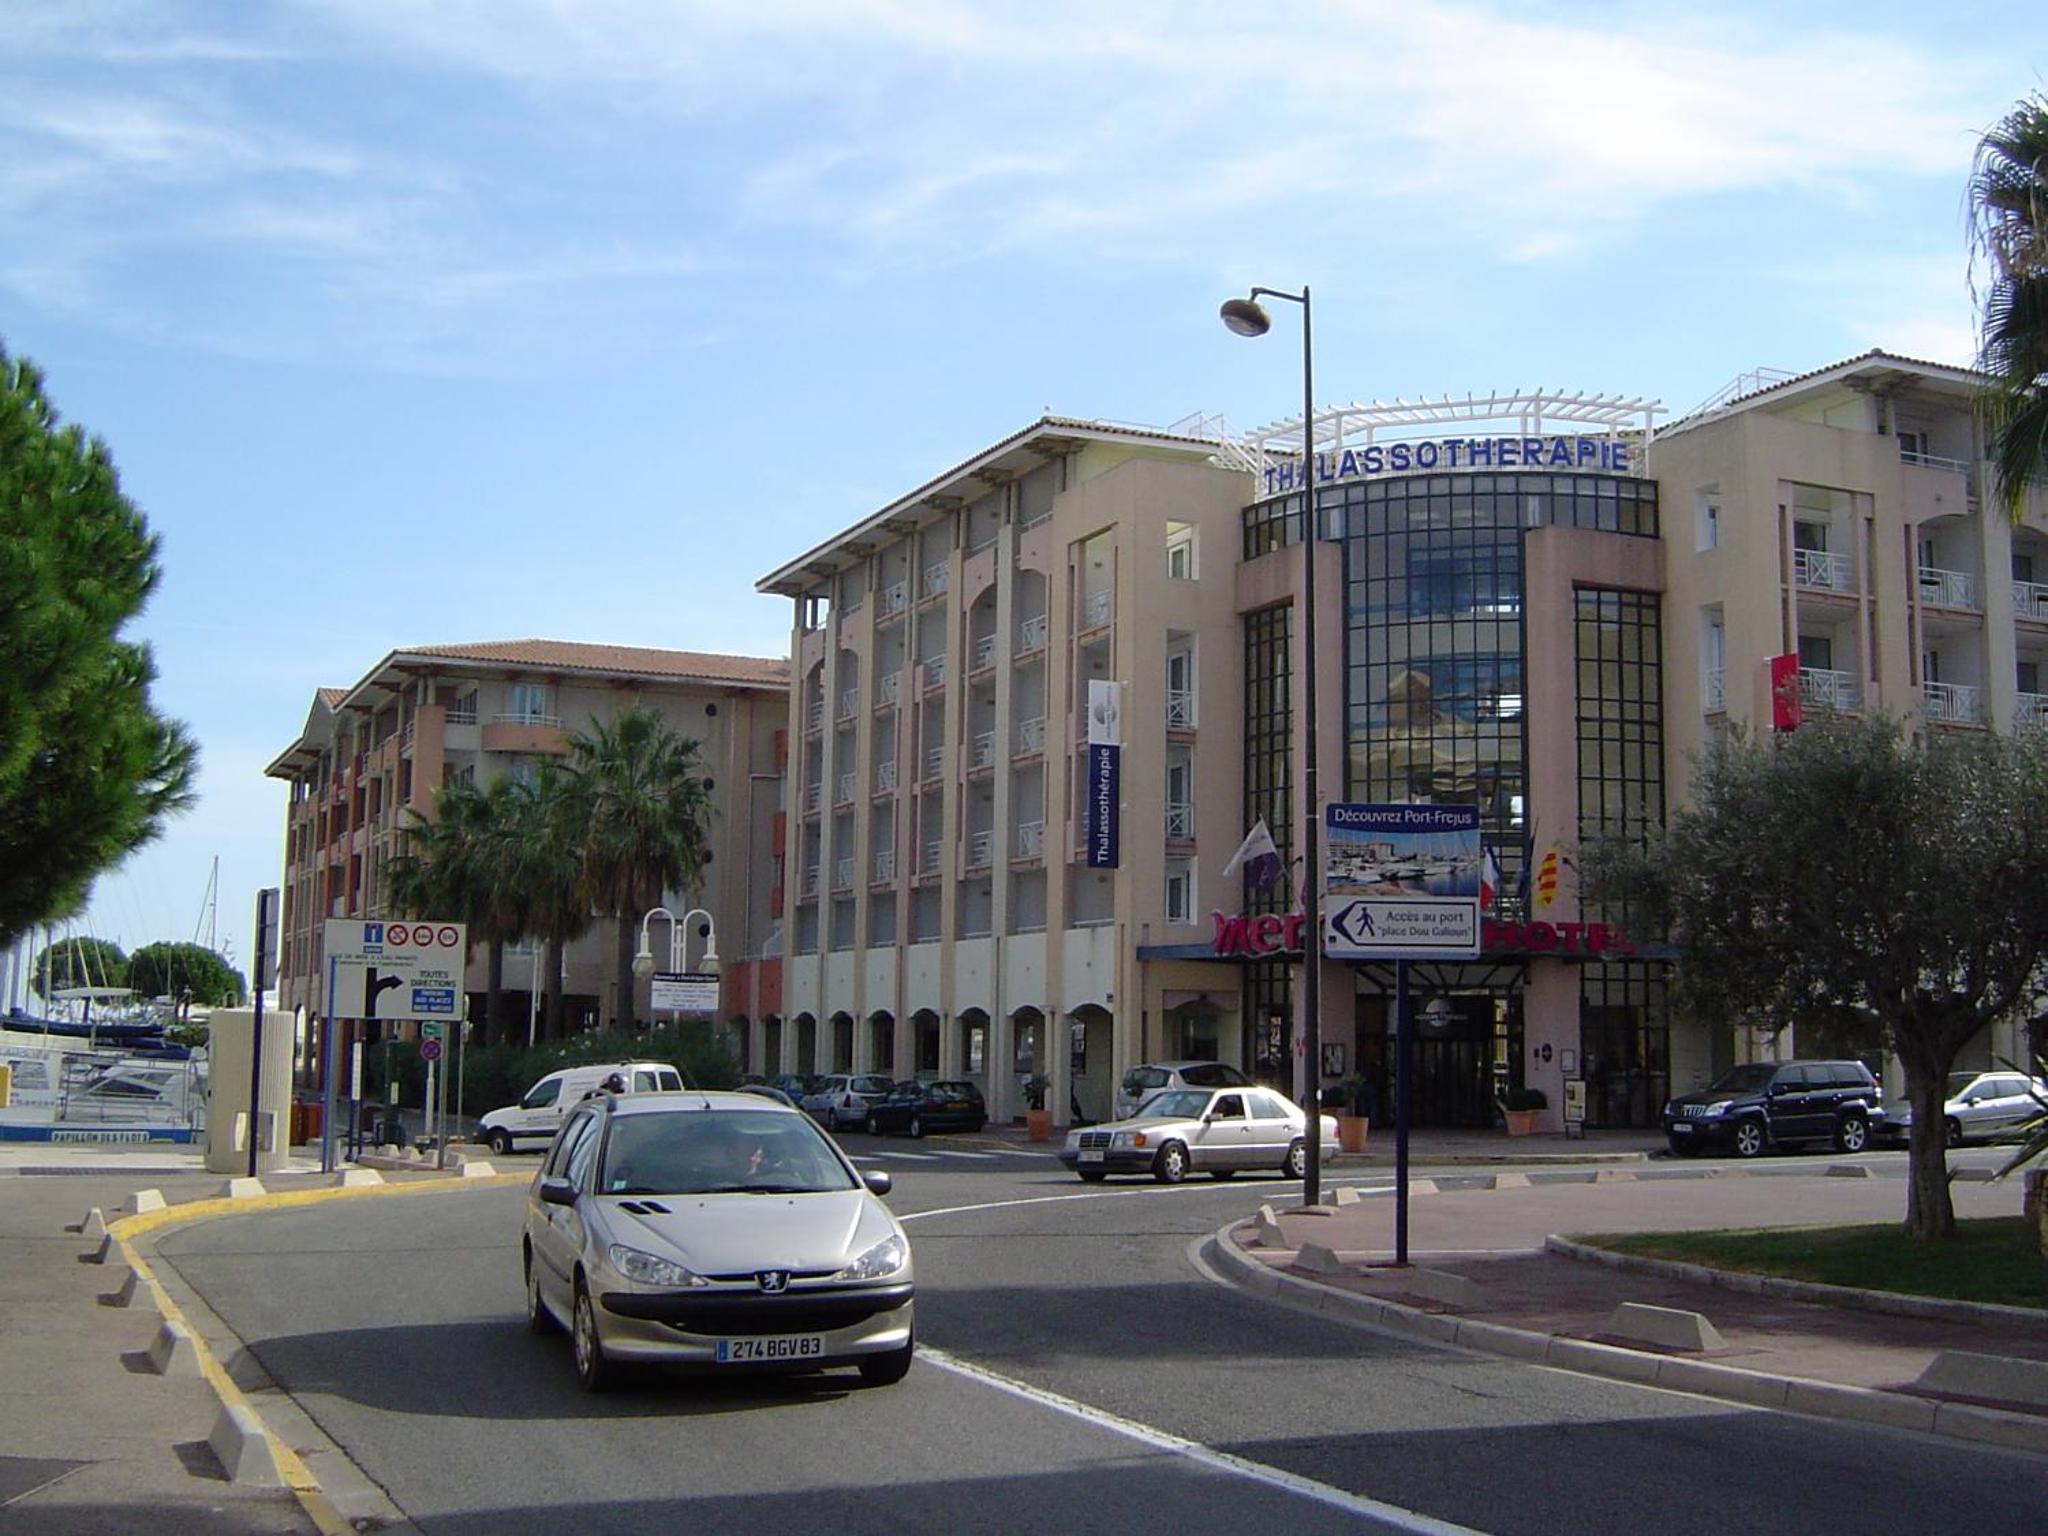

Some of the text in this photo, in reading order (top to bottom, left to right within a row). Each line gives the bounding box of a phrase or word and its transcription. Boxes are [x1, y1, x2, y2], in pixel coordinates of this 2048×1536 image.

[1334, 808, 1401, 823] Découvrez
[1422, 914, 1436, 923] au
[1439, 911, 1464, 926] port
[733, 1338, 821, 1359] 274 BGV 83
